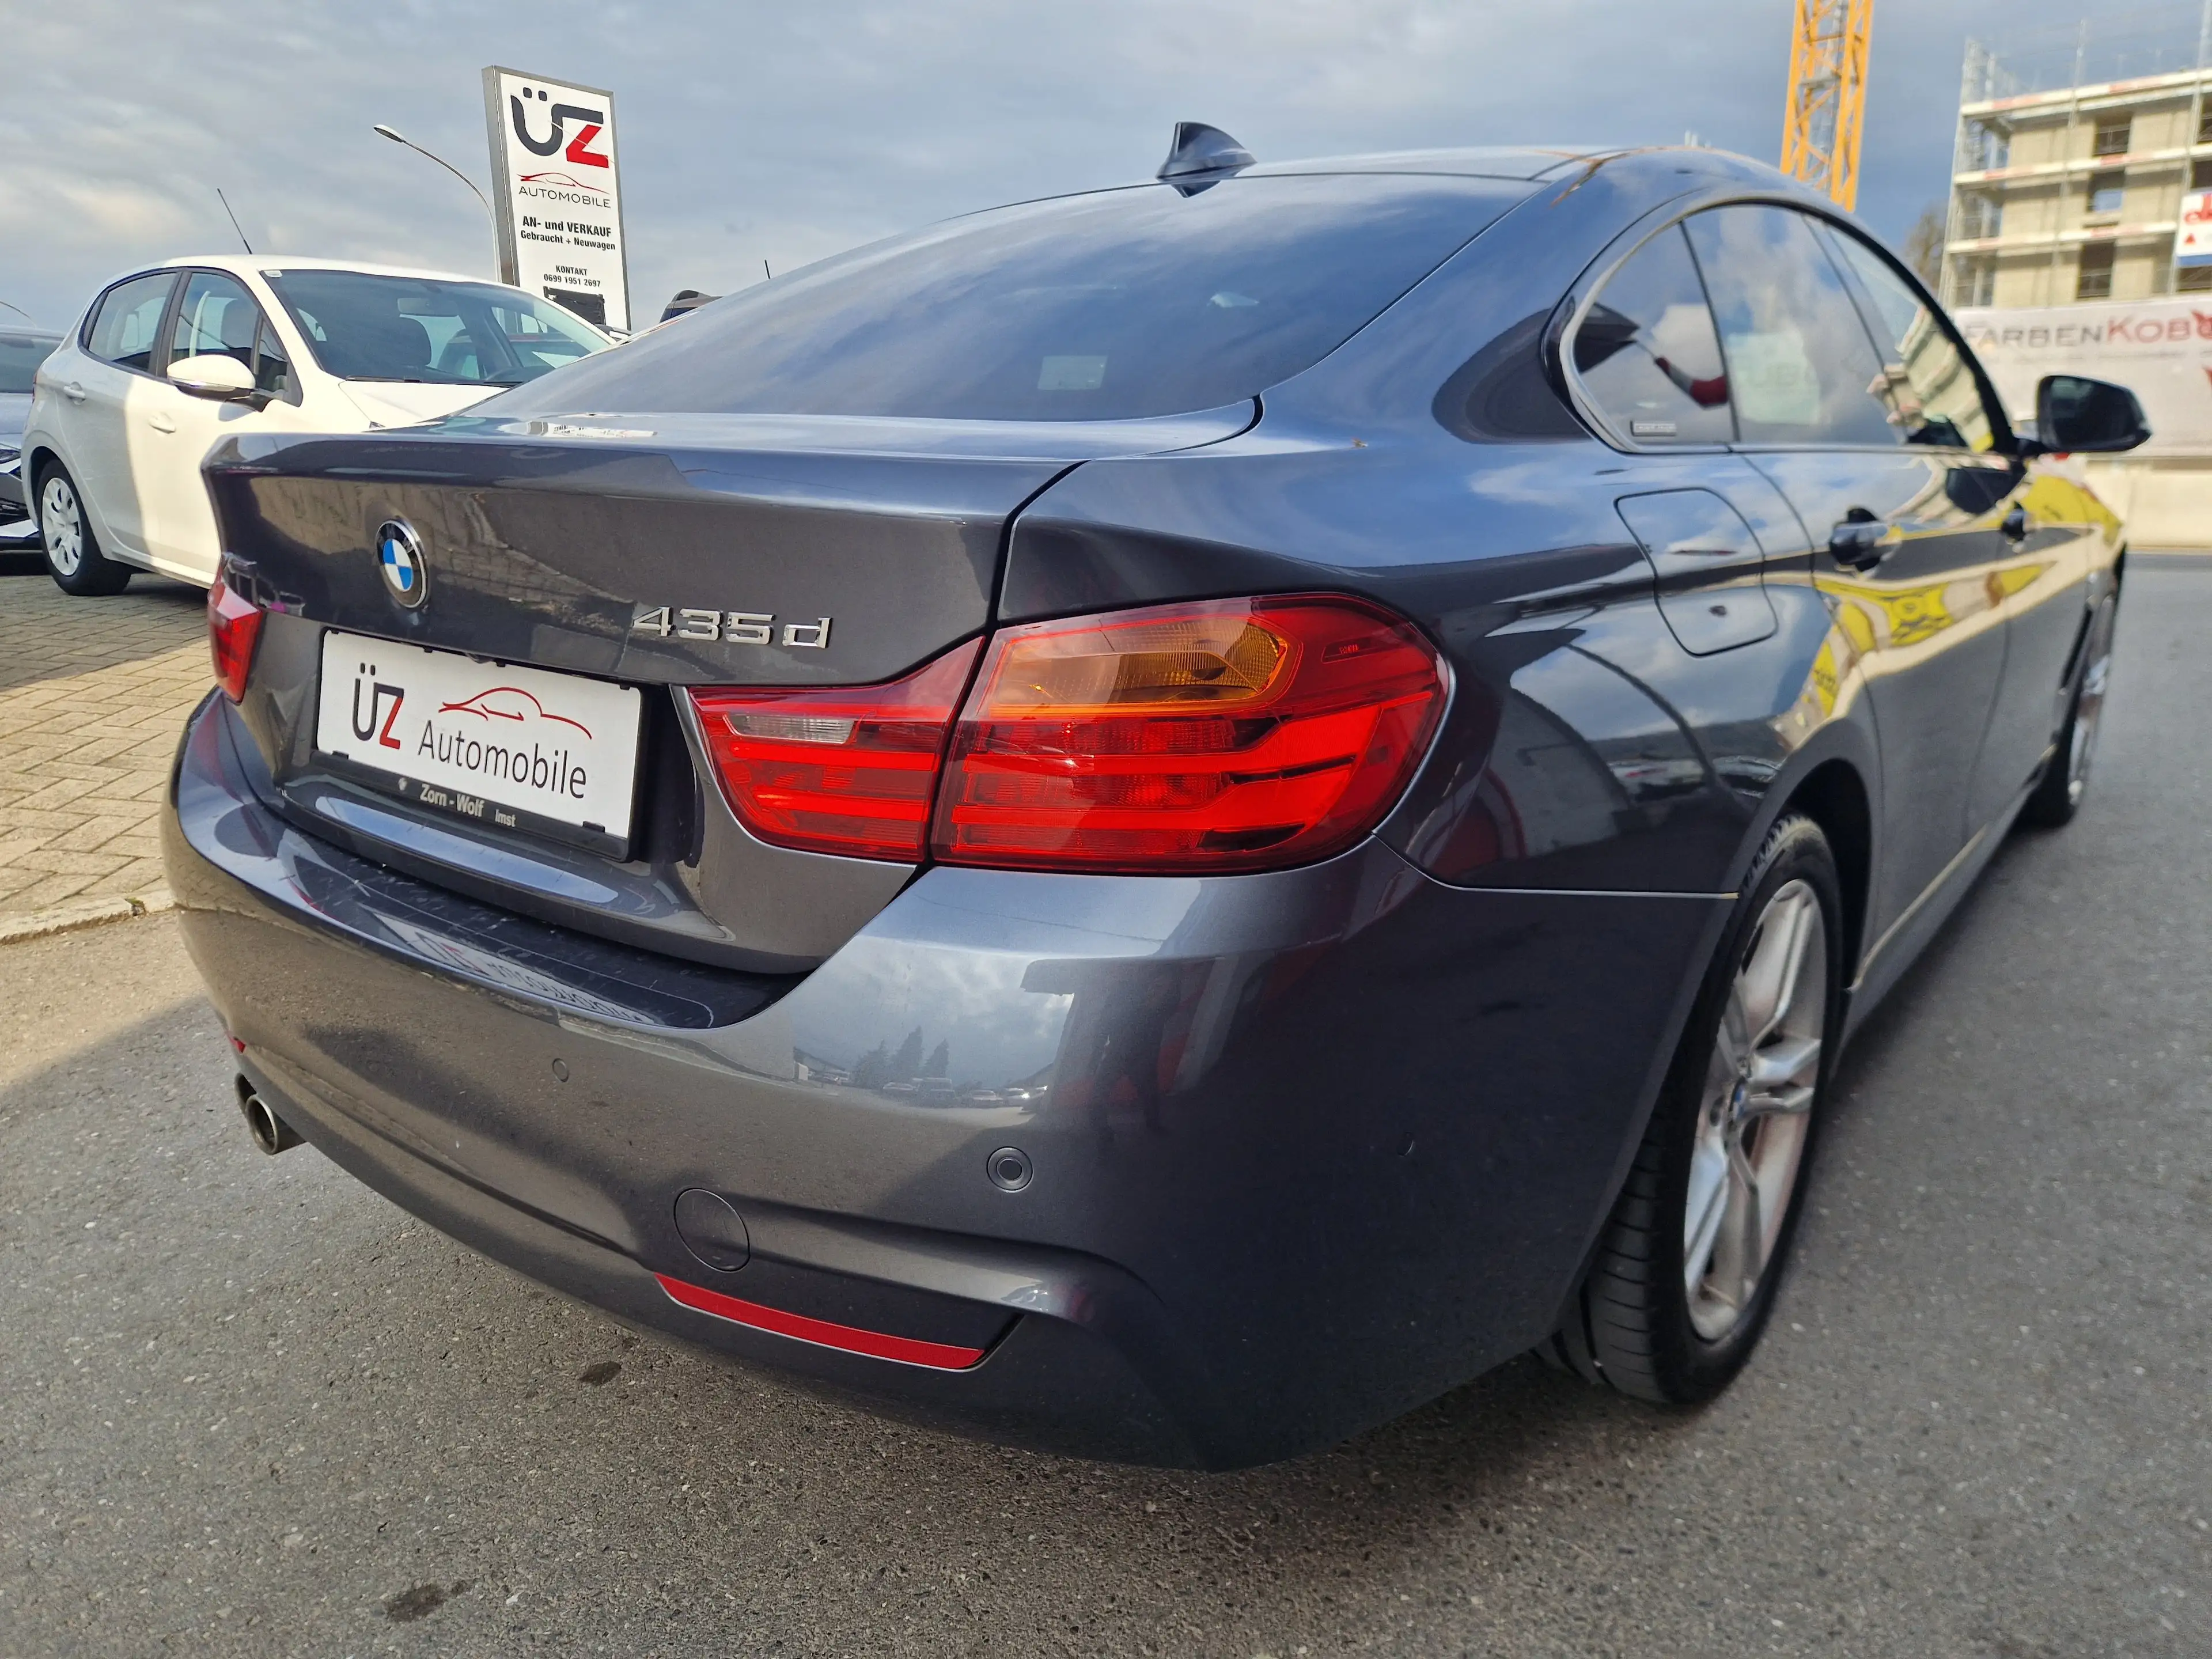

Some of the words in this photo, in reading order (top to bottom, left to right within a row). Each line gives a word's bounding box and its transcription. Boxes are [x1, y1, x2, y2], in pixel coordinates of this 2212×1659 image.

[510, 87, 609, 169] ÜZ
[519, 186, 611, 209] AUTOMOBILE
[522, 215, 541, 228] AN-
[545, 221, 564, 231] und
[567, 222, 611, 237] VERKAUF
[521, 230, 563, 244] Gebraucht
[574, 237, 616, 251] Neuwagen
[544, 274, 562, 283] 0699
[565, 276, 581, 285] 1951
[584, 278, 601, 287] 2697
[556, 265, 588, 276] KONTAKT
[352, 662, 404, 749] ÜZ
[418, 720, 586, 798] Automobile
[420, 784, 447, 806] Zorn
[457, 794, 484, 817] Wolf
